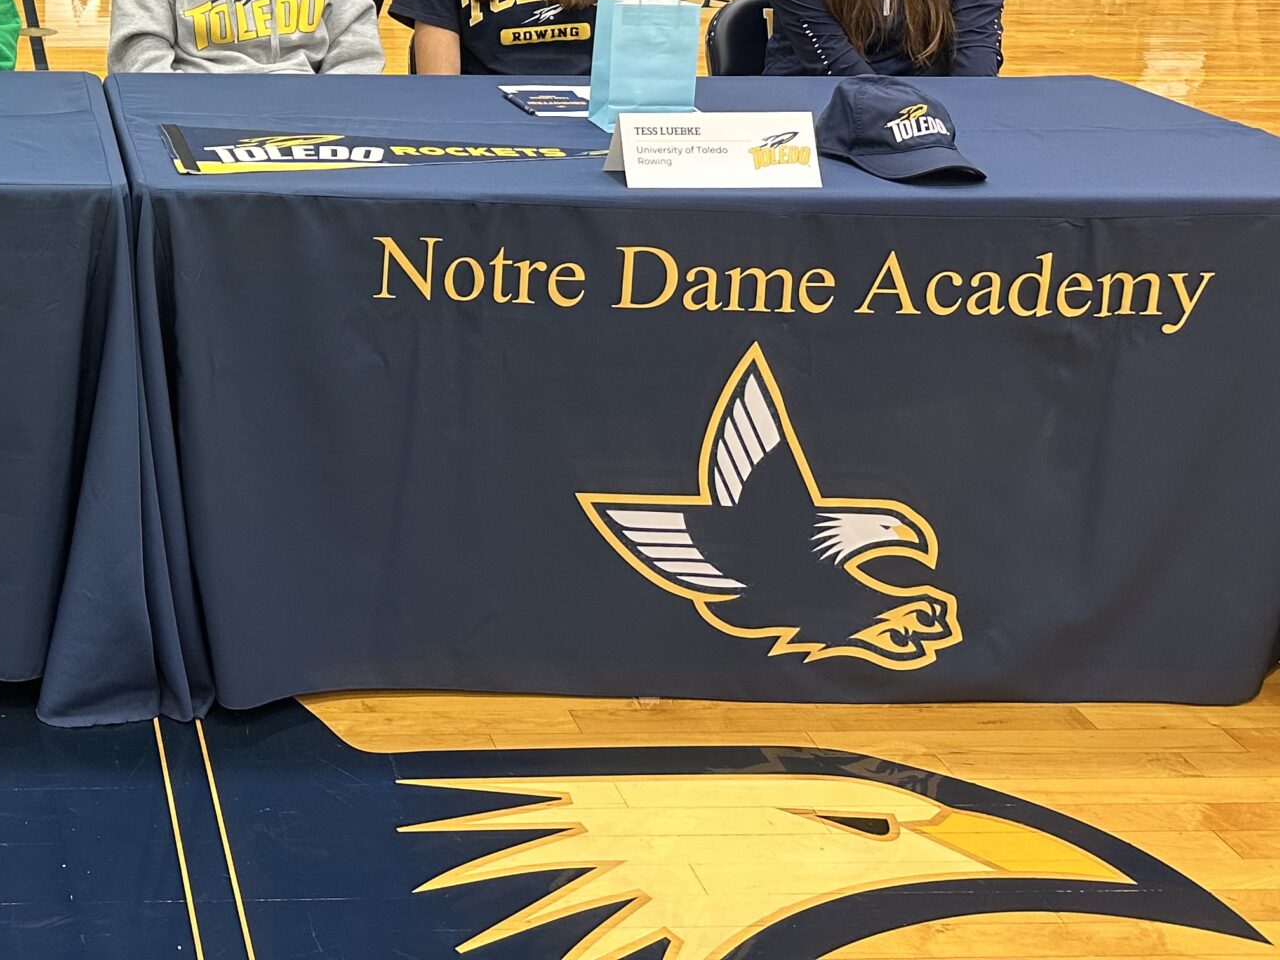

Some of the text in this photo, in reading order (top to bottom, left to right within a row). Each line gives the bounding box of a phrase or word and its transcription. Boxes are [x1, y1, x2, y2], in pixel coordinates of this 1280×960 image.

[512, 27, 579, 41] ROWING
[634, 127, 701, 136] TESS LUEBKE
[885, 116, 948, 143] TOLEDO
[203, 145, 566, 164] TOLEDO ROCKETS
[636, 145, 728, 156] University of Toledo
[749, 145, 811, 170] TOLEDO
[637, 157, 673, 166] Rowing
[373, 236, 1216, 335] Notre Dame Academy
